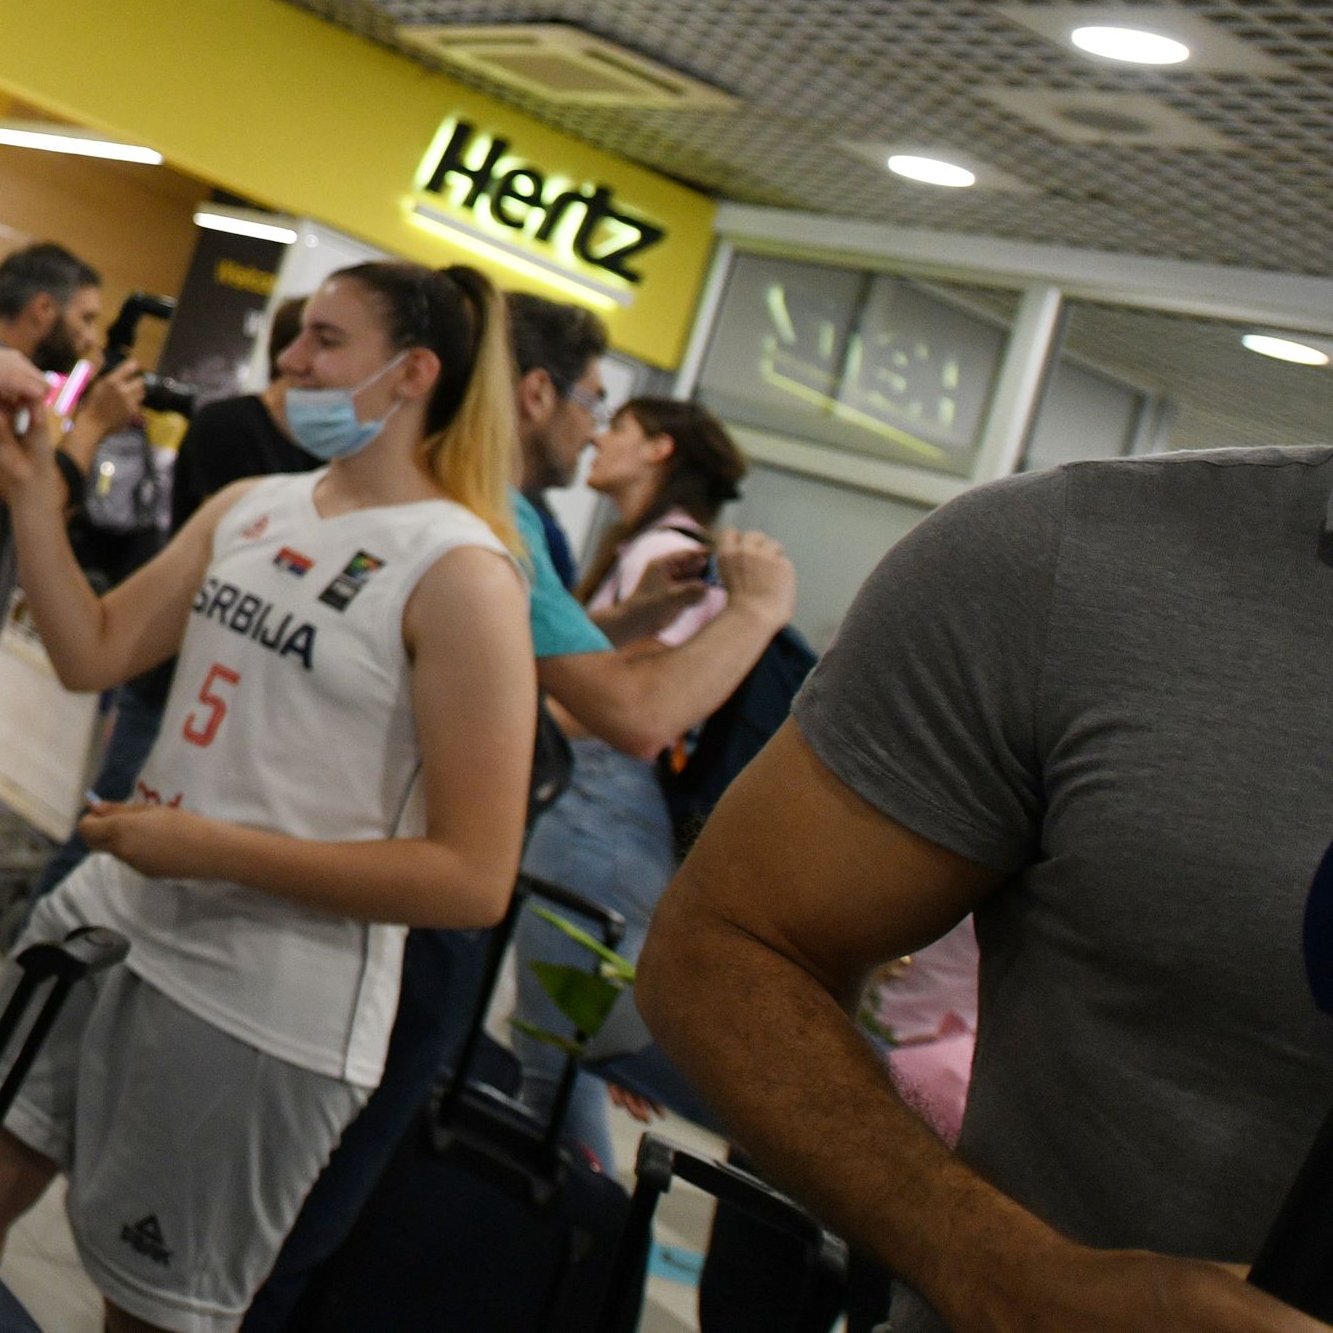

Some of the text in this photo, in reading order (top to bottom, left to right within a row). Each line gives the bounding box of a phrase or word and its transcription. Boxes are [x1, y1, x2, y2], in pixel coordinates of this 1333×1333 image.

[424, 120, 666, 284] Hertz
[190, 576, 318, 671] SRBIJA
[182, 662, 241, 747] 5
